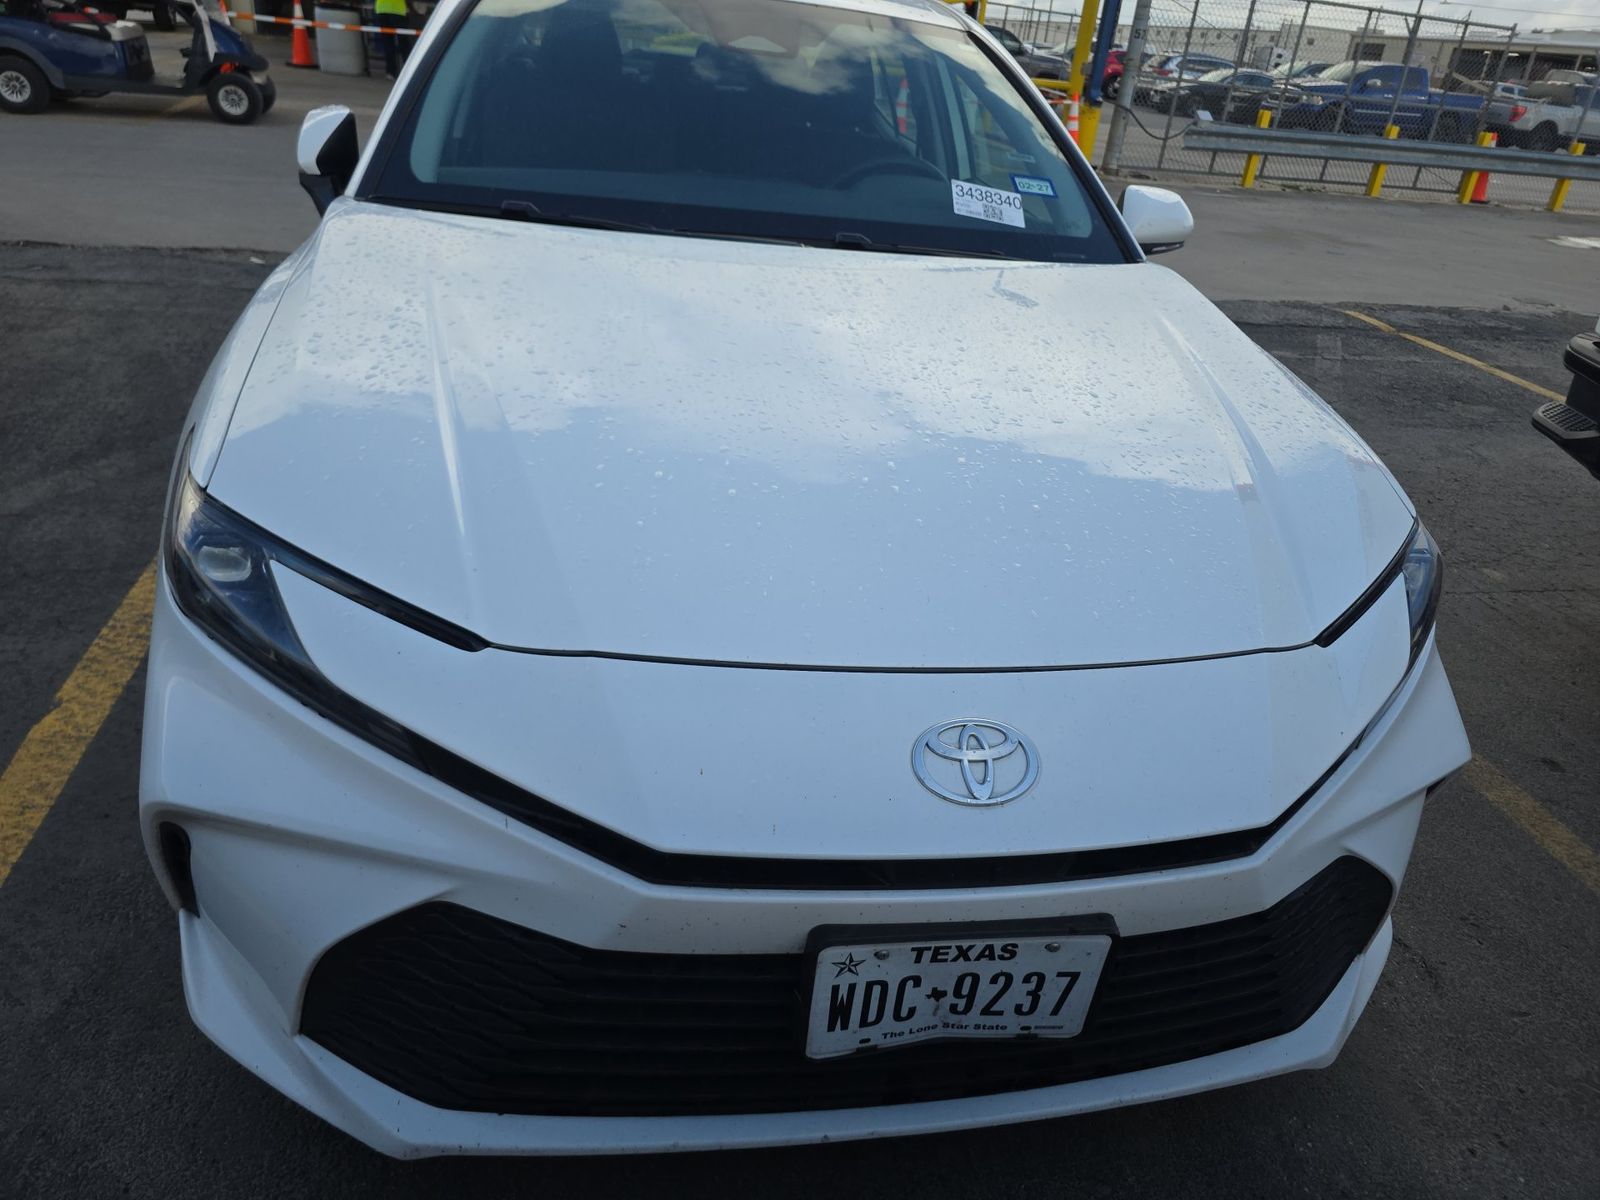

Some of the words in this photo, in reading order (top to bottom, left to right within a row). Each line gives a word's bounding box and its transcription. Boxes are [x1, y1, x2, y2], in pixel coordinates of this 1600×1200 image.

[955, 184, 1022, 210] 3438340
[911, 942, 1018, 964] TEXAS
[826, 974, 922, 1033] WDC
[948, 971, 1081, 1017] 9237
[882, 1029, 905, 1040] The
[908, 1023, 937, 1035] Lone
[942, 1022, 970, 1031] Star
[973, 1023, 1008, 1031] State
